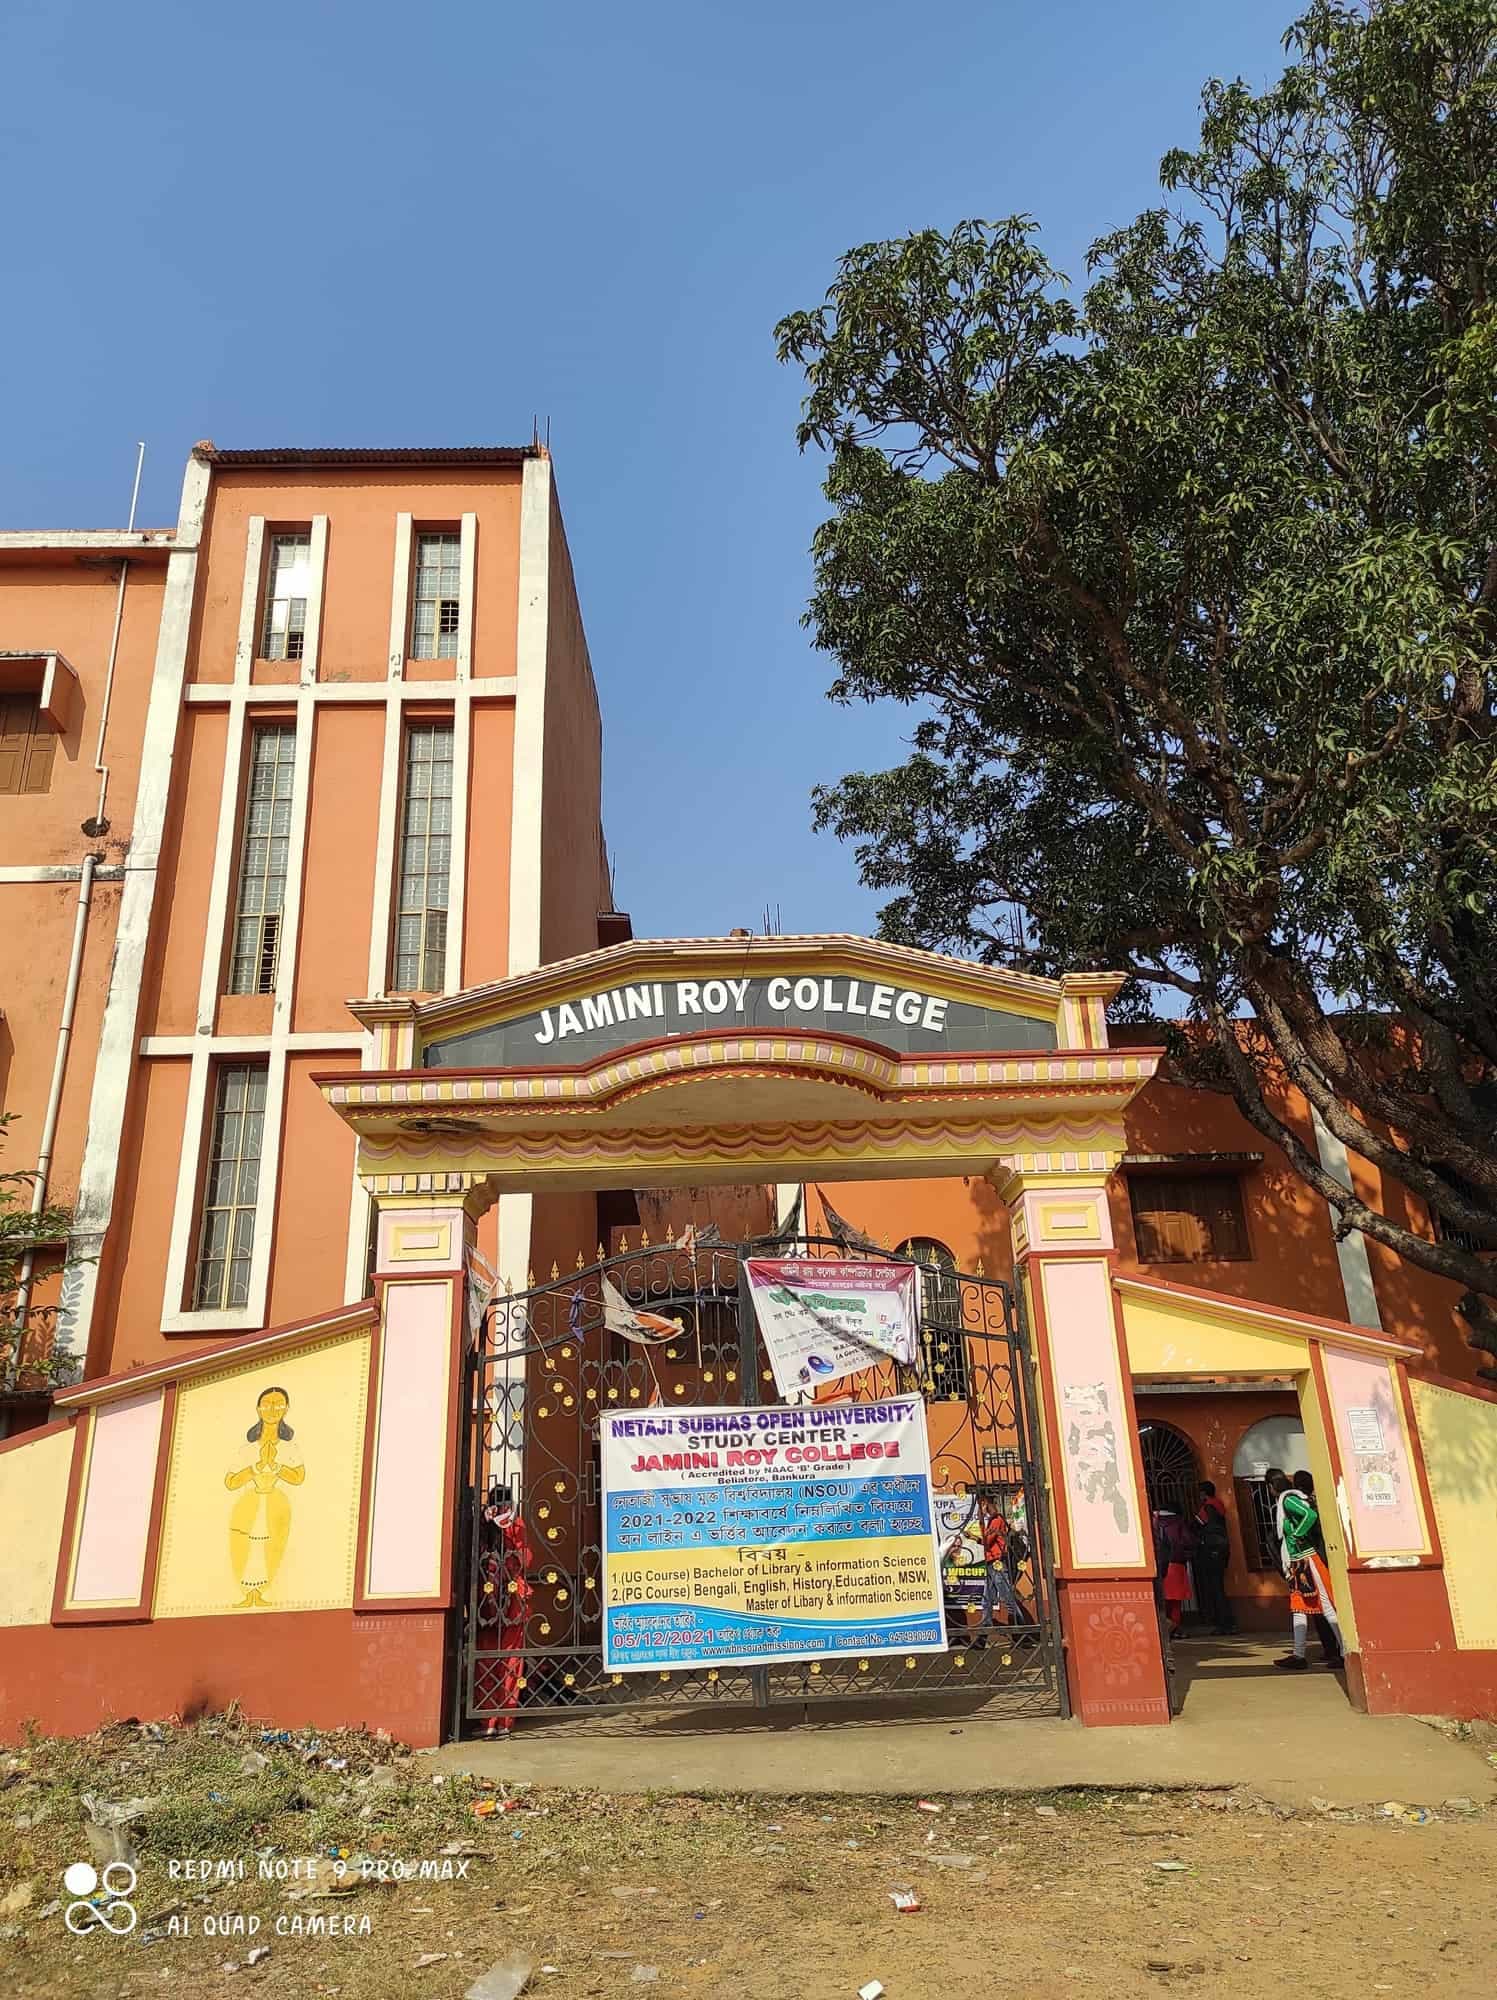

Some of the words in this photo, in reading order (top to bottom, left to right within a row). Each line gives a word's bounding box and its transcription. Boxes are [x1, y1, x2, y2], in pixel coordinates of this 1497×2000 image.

[534, 983, 664, 1044] JAMINI
[677, 978, 750, 1016] ROY
[767, 977, 949, 1032] COLLEGE
[611, 1419, 673, 1438] NETAJI
[679, 1414, 750, 1434] SUBHAS
[756, 1411, 805, 1430] OPEN
[810, 1403, 916, 1427] UNIVERSITY
[688, 1432, 757, 1449] STUDY
[764, 1427, 847, 1446] CENTER
[631, 1452, 718, 1472] JAMINI
[727, 1448, 778, 1468] ROY
[785, 1441, 900, 1463] COLLEGE
[749, 1467, 760, 1477] by
[764, 1465, 794, 1474] NAAC
[813, 1463, 845, 1472] Grade
[772, 1473, 816, 1481] Bankura
[661, 1491, 692, 1507] সুভাষ
[697, 1490, 718, 1505] মুক্ত
[861, 1481, 878, 1495] এর
[620, 1511, 717, 1528] 2021-2022
[648, 1528, 683, 1545] লাইন
[690, 1530, 701, 1541] এ
[752, 1524, 808, 1539] আবেদন
[813, 1522, 853, 1536] করতে
[859, 1517, 885, 1534] বলা
[737, 1546, 786, 1563] বিষয়
[645, 1568, 690, 1583] Course)
[693, 1566, 744, 1579] Bachelor
[749, 1563, 759, 1576] of
[762, 1561, 801, 1577] Library
[804, 1561, 813, 1572] &
[816, 1557, 880, 1571] information
[883, 1556, 927, 1568] Science
[646, 1584, 690, 1600] Course)
[694, 1582, 740, 1599] Bengali,
[744, 1578, 790, 1596] English,
[898, 1570, 930, 1585] MSW,
[746, 1598, 778, 1611] Master
[781, 1595, 791, 1608] of
[793, 1594, 824, 1610] Libary
[826, 1593, 834, 1606] &
[836, 1590, 892, 1605] information
[895, 1588, 933, 1602] Science
[613, 1627, 714, 1648] 05/12/2021
[835, 1634, 868, 1648] Contact
